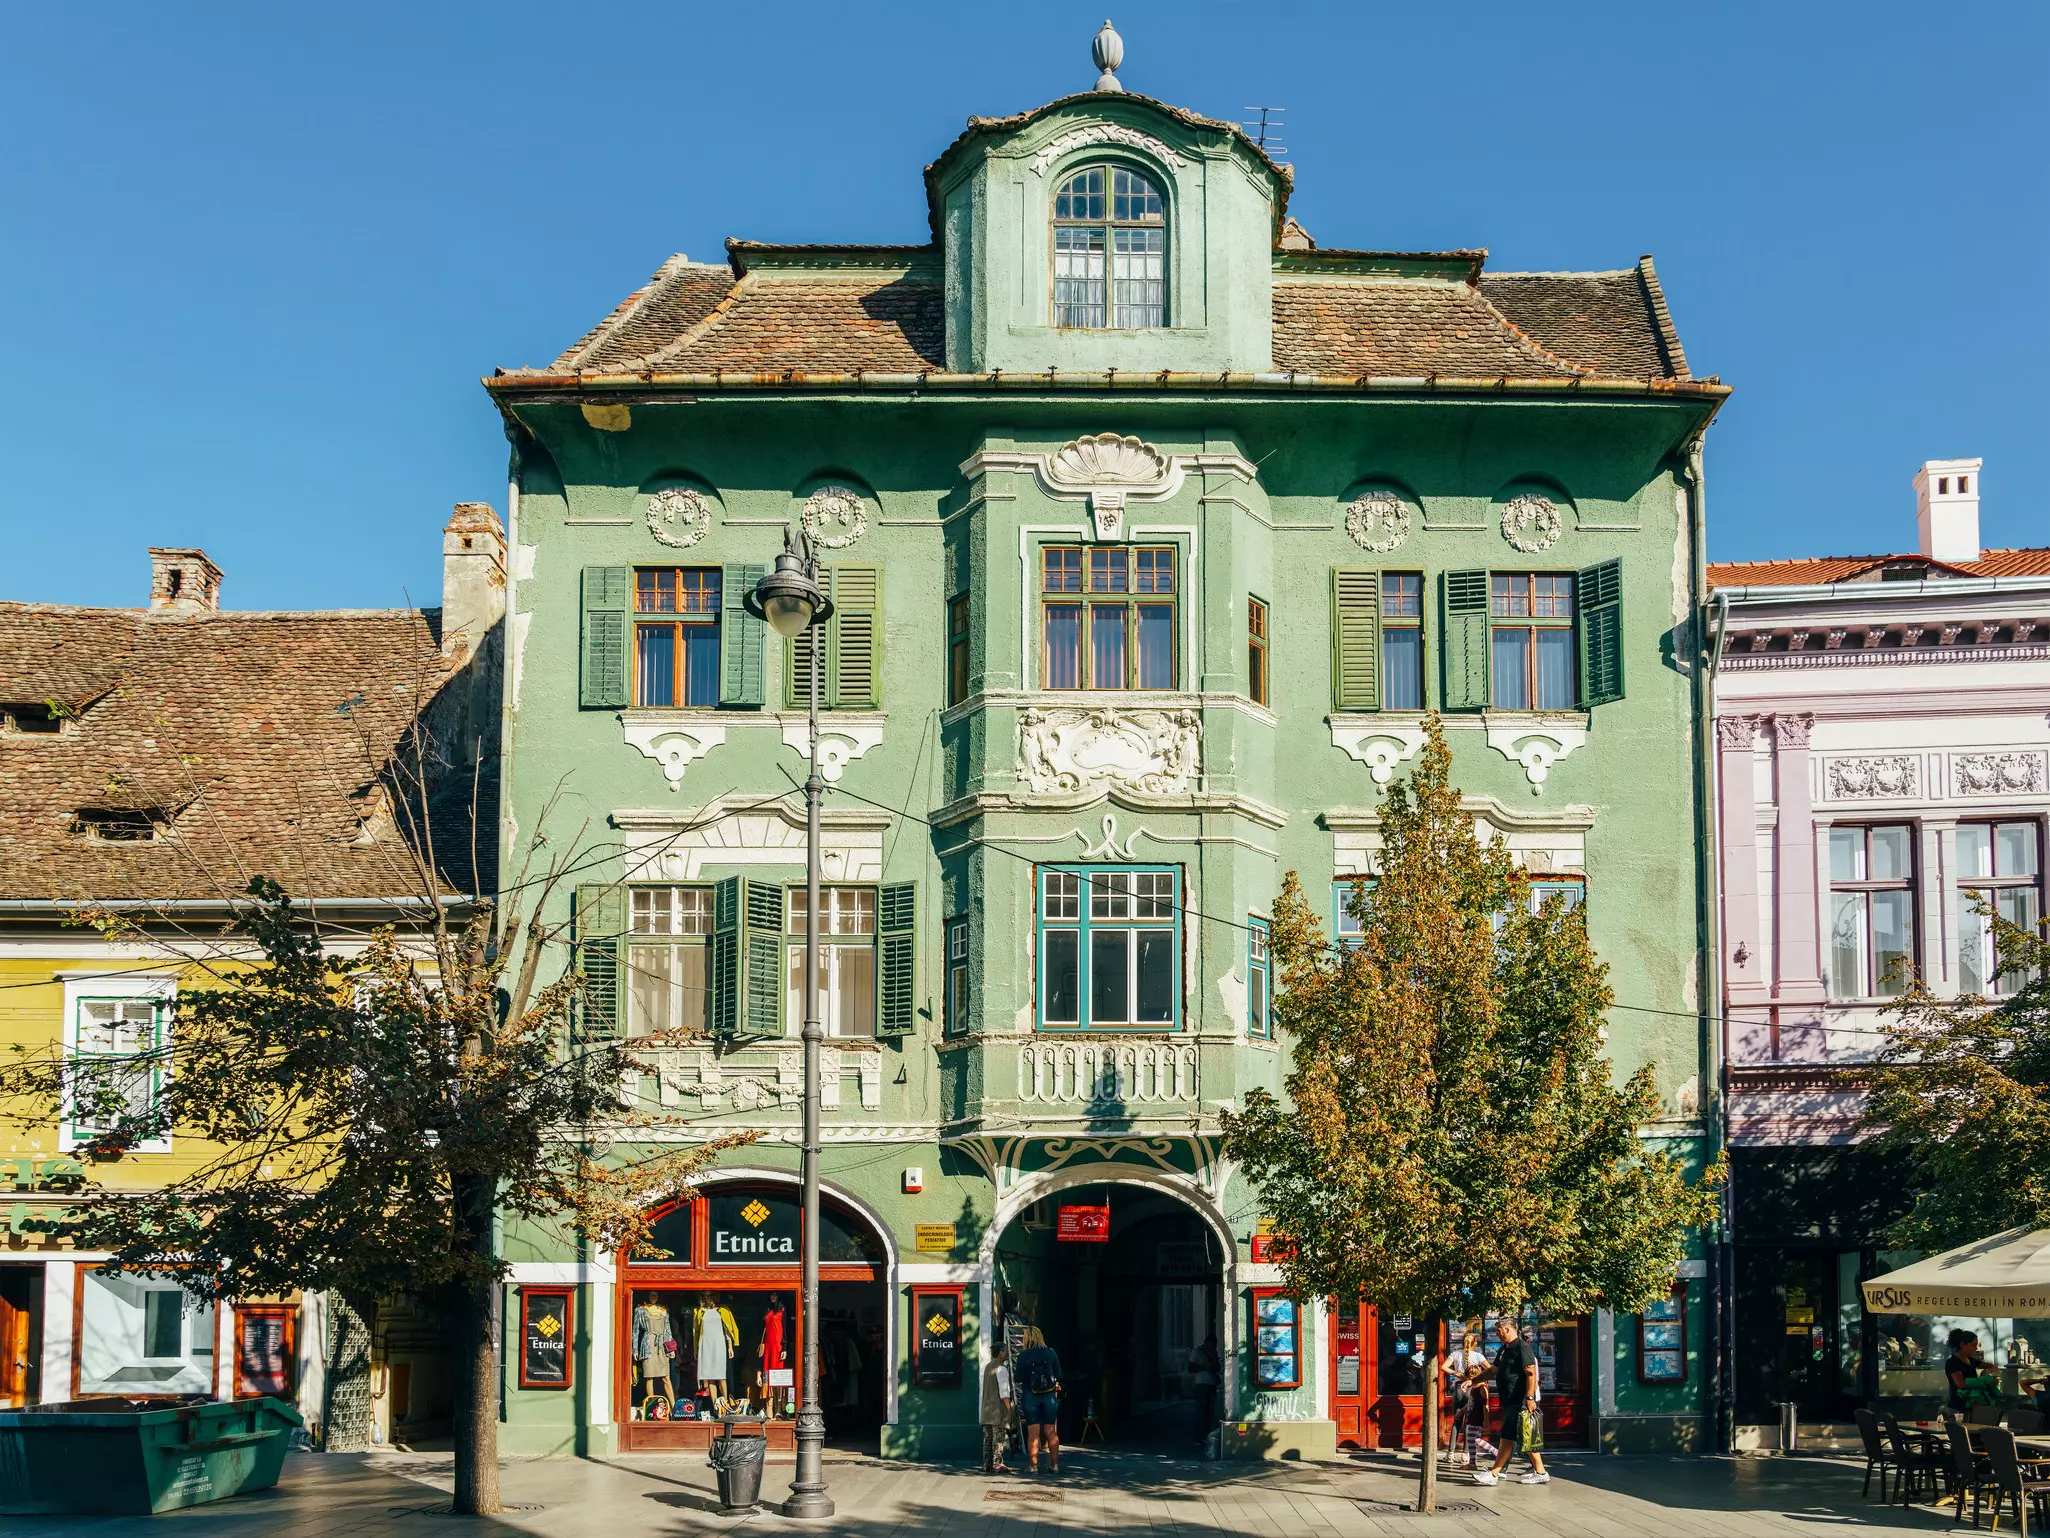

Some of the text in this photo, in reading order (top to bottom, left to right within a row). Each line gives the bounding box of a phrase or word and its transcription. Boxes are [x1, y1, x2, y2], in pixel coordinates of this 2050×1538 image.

[716, 1231, 794, 1253] Etnica
[1867, 1287, 2050, 1309] URSUS REGELE BERII ÎN ROM
[532, 1339, 564, 1349] Etnica
[922, 1339, 954, 1349] Etnica
